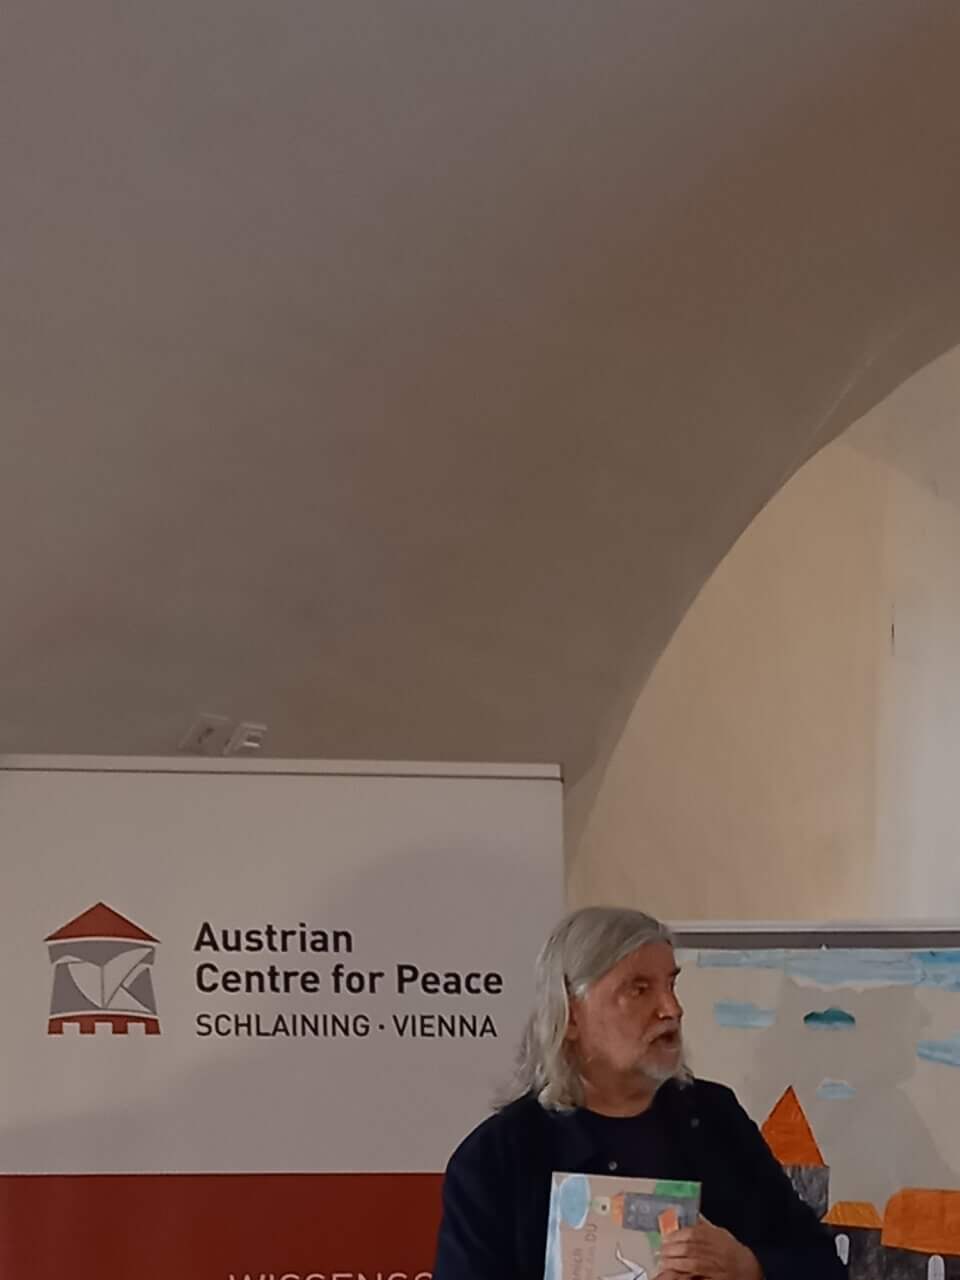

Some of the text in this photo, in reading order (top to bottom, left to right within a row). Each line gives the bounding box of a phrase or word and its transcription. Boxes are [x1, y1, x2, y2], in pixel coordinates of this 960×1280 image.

[194, 922, 352, 953] Austrian
[196, 963, 503, 995] Centre for Peace
[196, 1013, 370, 1037] SCHLAINING
[392, 1014, 498, 1038] VIENNA
